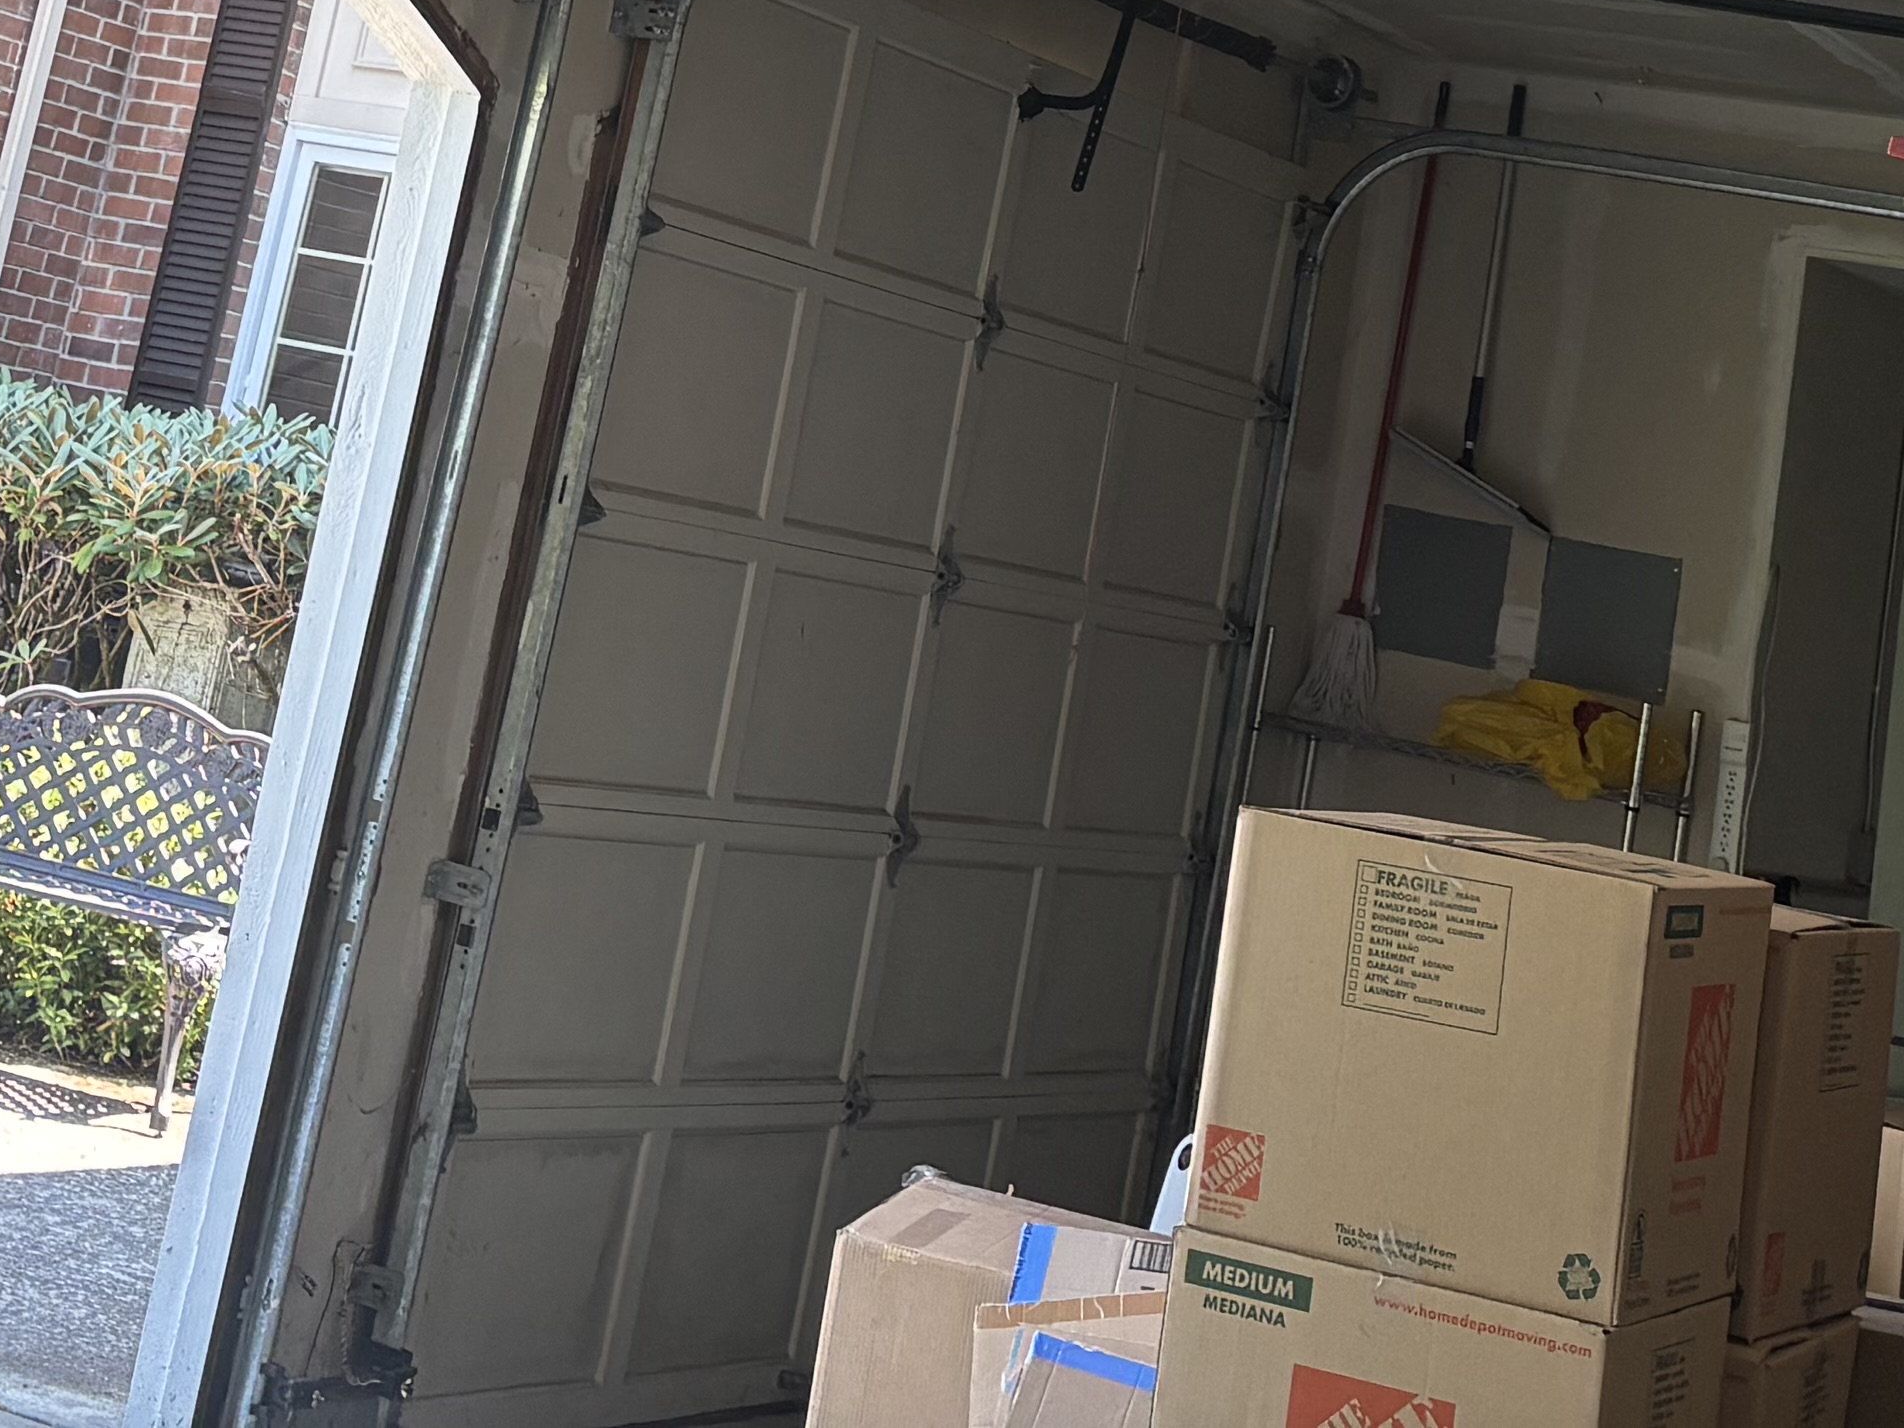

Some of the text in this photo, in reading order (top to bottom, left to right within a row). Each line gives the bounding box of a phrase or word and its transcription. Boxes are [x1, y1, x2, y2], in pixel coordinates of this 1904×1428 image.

[1377, 870, 1448, 895] FRAGILE
[1203, 1133, 1264, 1191] HOME
[1212, 1135, 1235, 1158] THE
[1224, 1159, 1261, 1195] DEPOT
[1335, 1223, 1356, 1236] This
[1395, 1238, 1426, 1252] made
[1428, 1244, 1456, 1259] from
[1337, 1234, 1368, 1250] 100%
[1202, 1260, 1295, 1300] MEDIUM
[1202, 1293, 1286, 1328] MEDIANA
[1374, 1295, 1592, 1358] www.homedepotmoving.com
